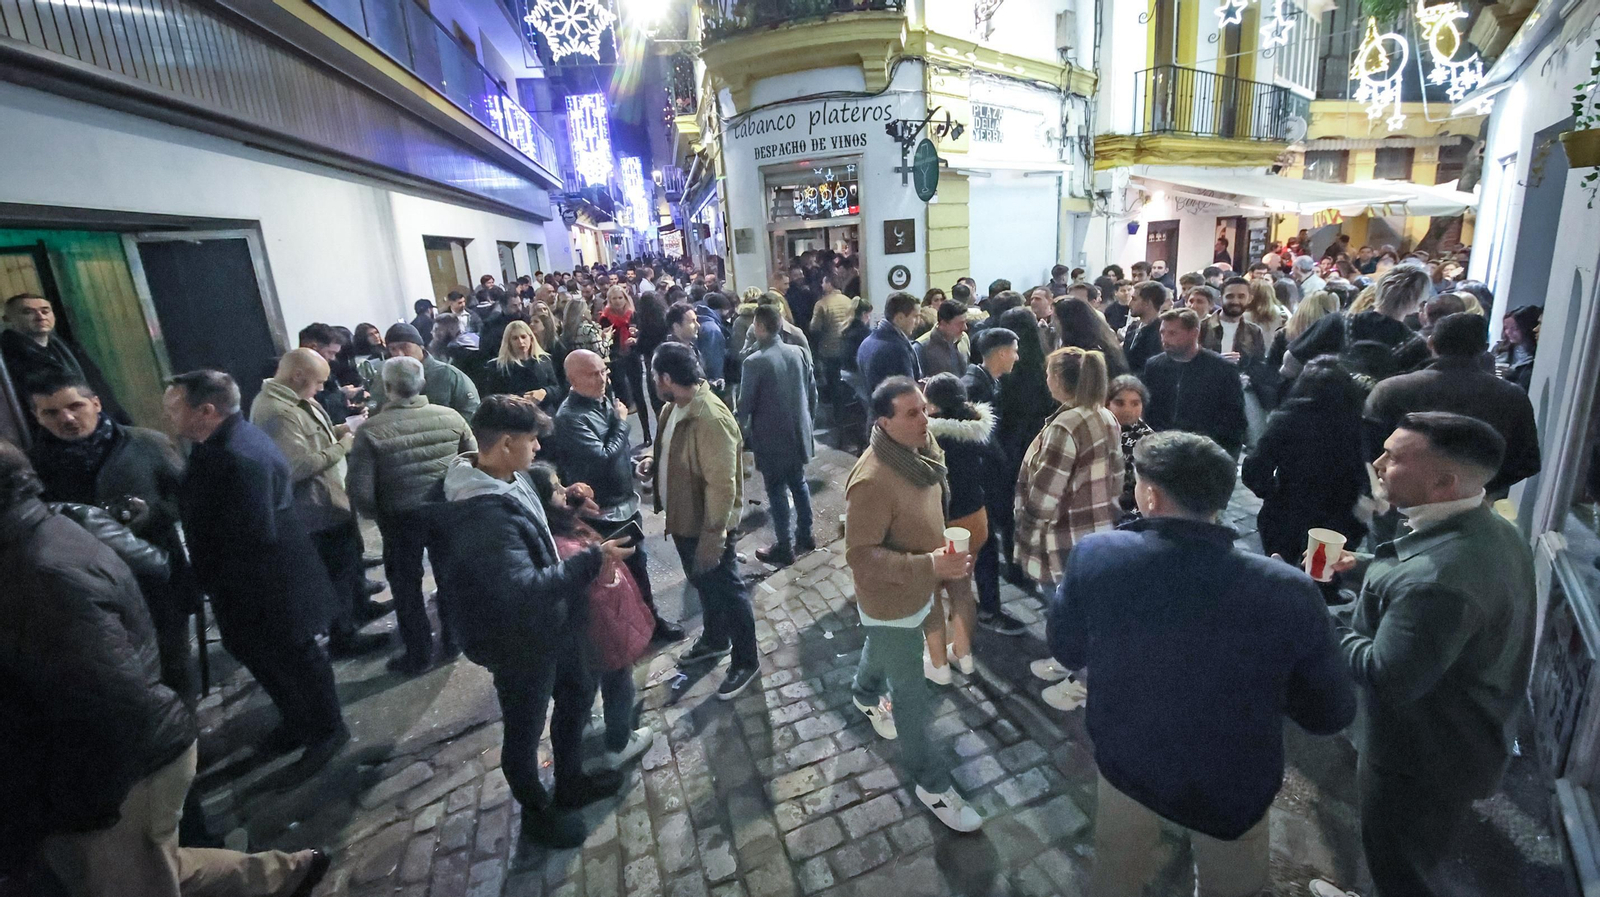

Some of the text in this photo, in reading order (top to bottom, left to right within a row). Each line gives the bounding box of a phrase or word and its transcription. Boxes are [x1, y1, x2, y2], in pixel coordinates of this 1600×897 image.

[809, 102, 892, 135] plateros
[754, 133, 868, 160] DESPACHO DE VINOS
